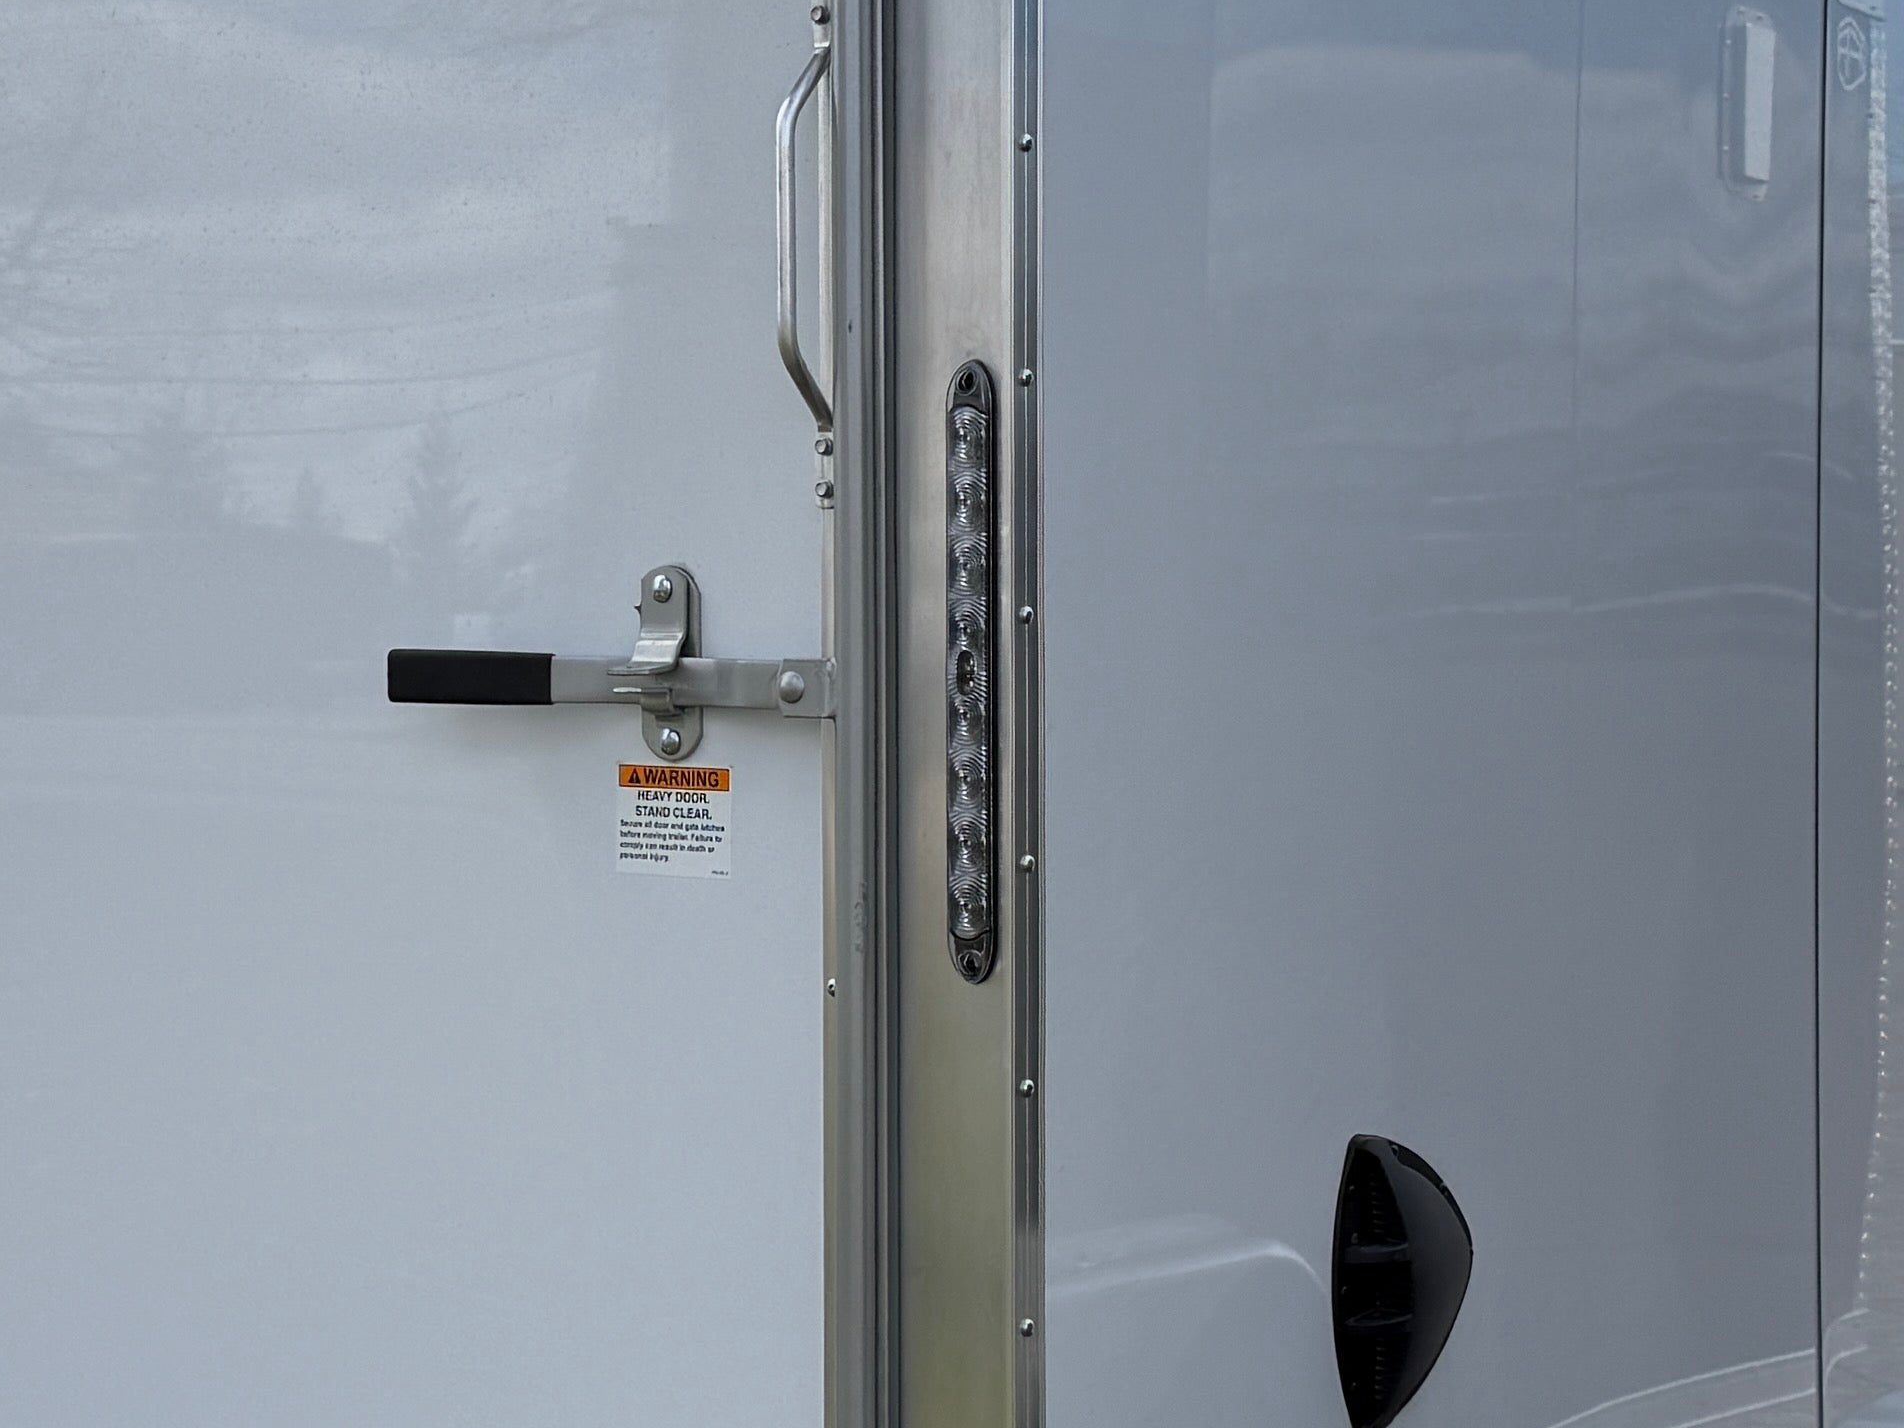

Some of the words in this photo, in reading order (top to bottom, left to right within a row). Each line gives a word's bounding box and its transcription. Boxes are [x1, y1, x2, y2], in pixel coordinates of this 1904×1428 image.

[643, 767, 720, 788] WARNING
[637, 790, 673, 801] HEAVY
[675, 792, 710, 804] DOOR.
[635, 805, 671, 817] STAND
[673, 807, 713, 820] CLEAR.
